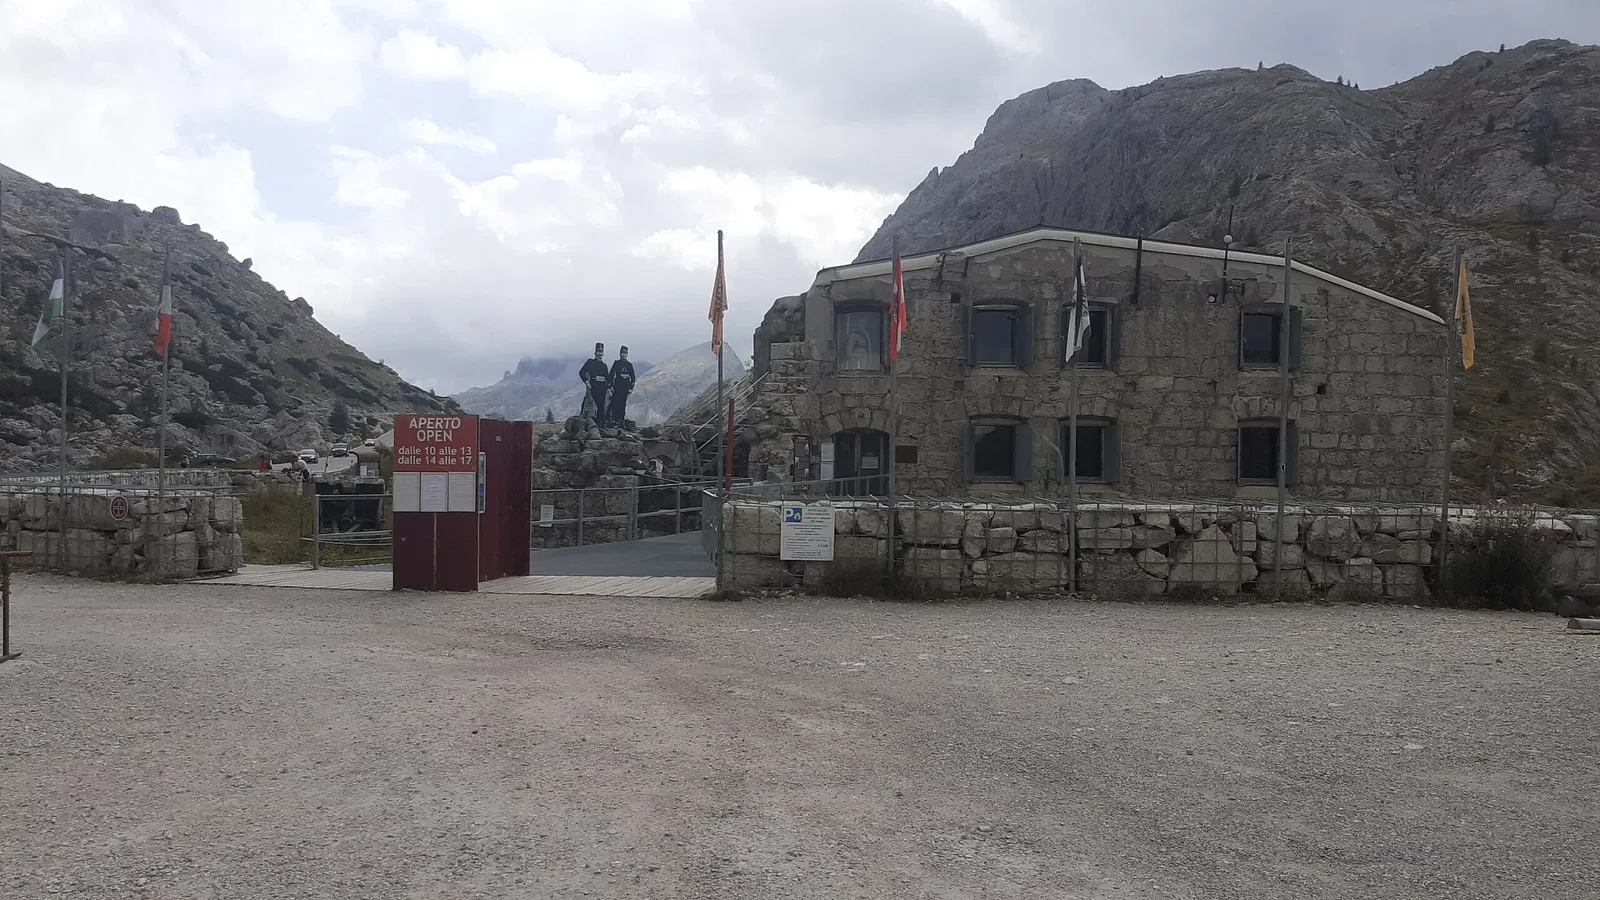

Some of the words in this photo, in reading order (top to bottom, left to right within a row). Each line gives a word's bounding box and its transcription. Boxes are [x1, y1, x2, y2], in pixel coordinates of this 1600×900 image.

[409, 417, 461, 429] APERTO
[417, 430, 453, 442] OPEN
[398, 446, 422, 455] dalle
[425, 446, 436, 455] 10
[439, 446, 457, 455] alle
[461, 446, 472, 455] 13
[398, 456, 422, 465] dalle
[425, 456, 436, 465] 14
[439, 456, 457, 465] alle
[461, 456, 473, 465] 17
